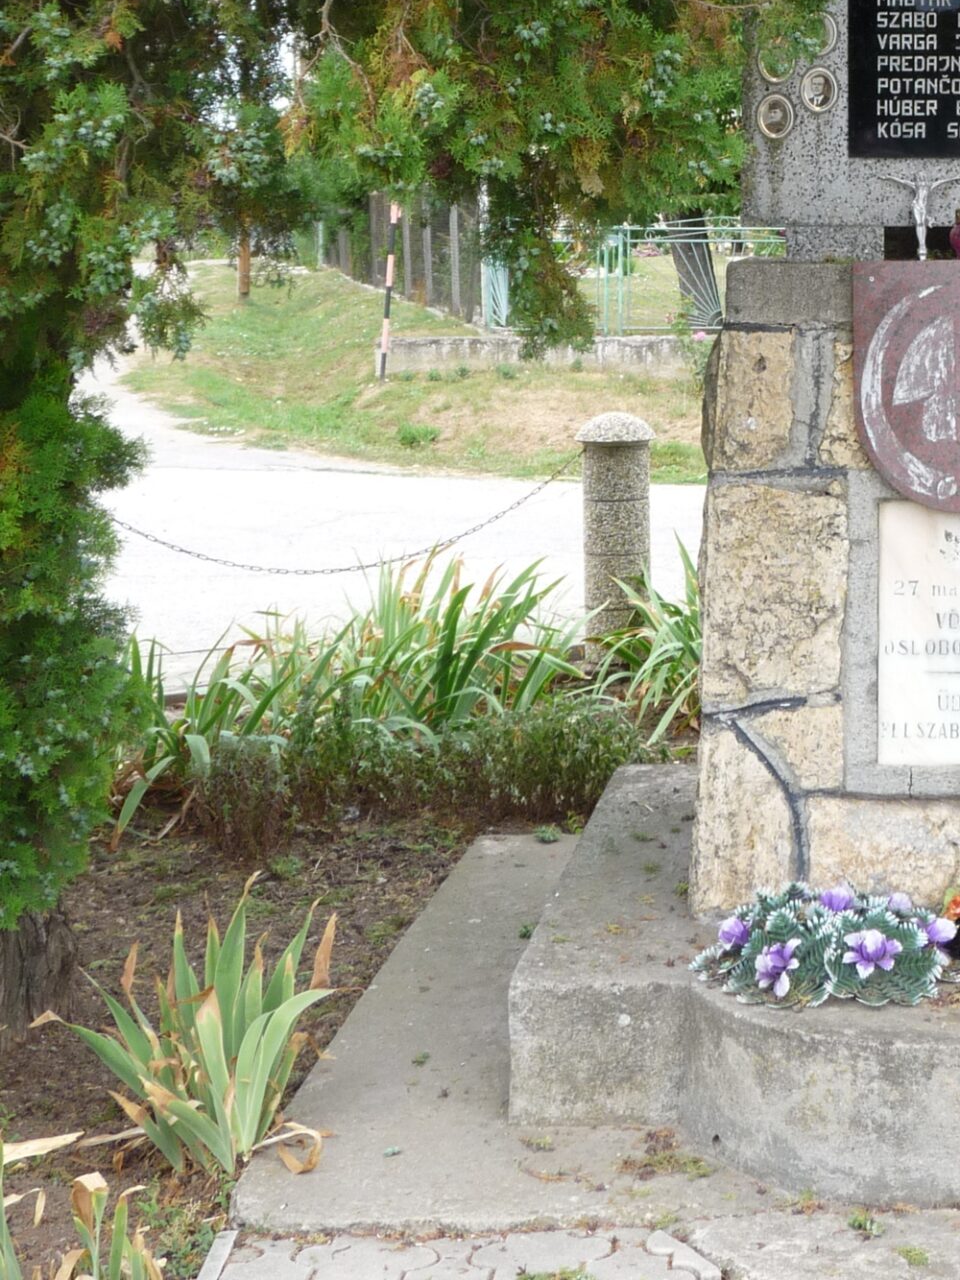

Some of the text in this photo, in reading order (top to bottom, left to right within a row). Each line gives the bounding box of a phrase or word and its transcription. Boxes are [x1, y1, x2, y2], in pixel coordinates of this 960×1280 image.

[876, 7, 937, 29] SZABÓ
[877, 34, 938, 51] VARGA
[876, 96, 938, 116] HÚBER
[877, 118, 927, 139] KÓSA
[893, 579, 919, 597] 27
